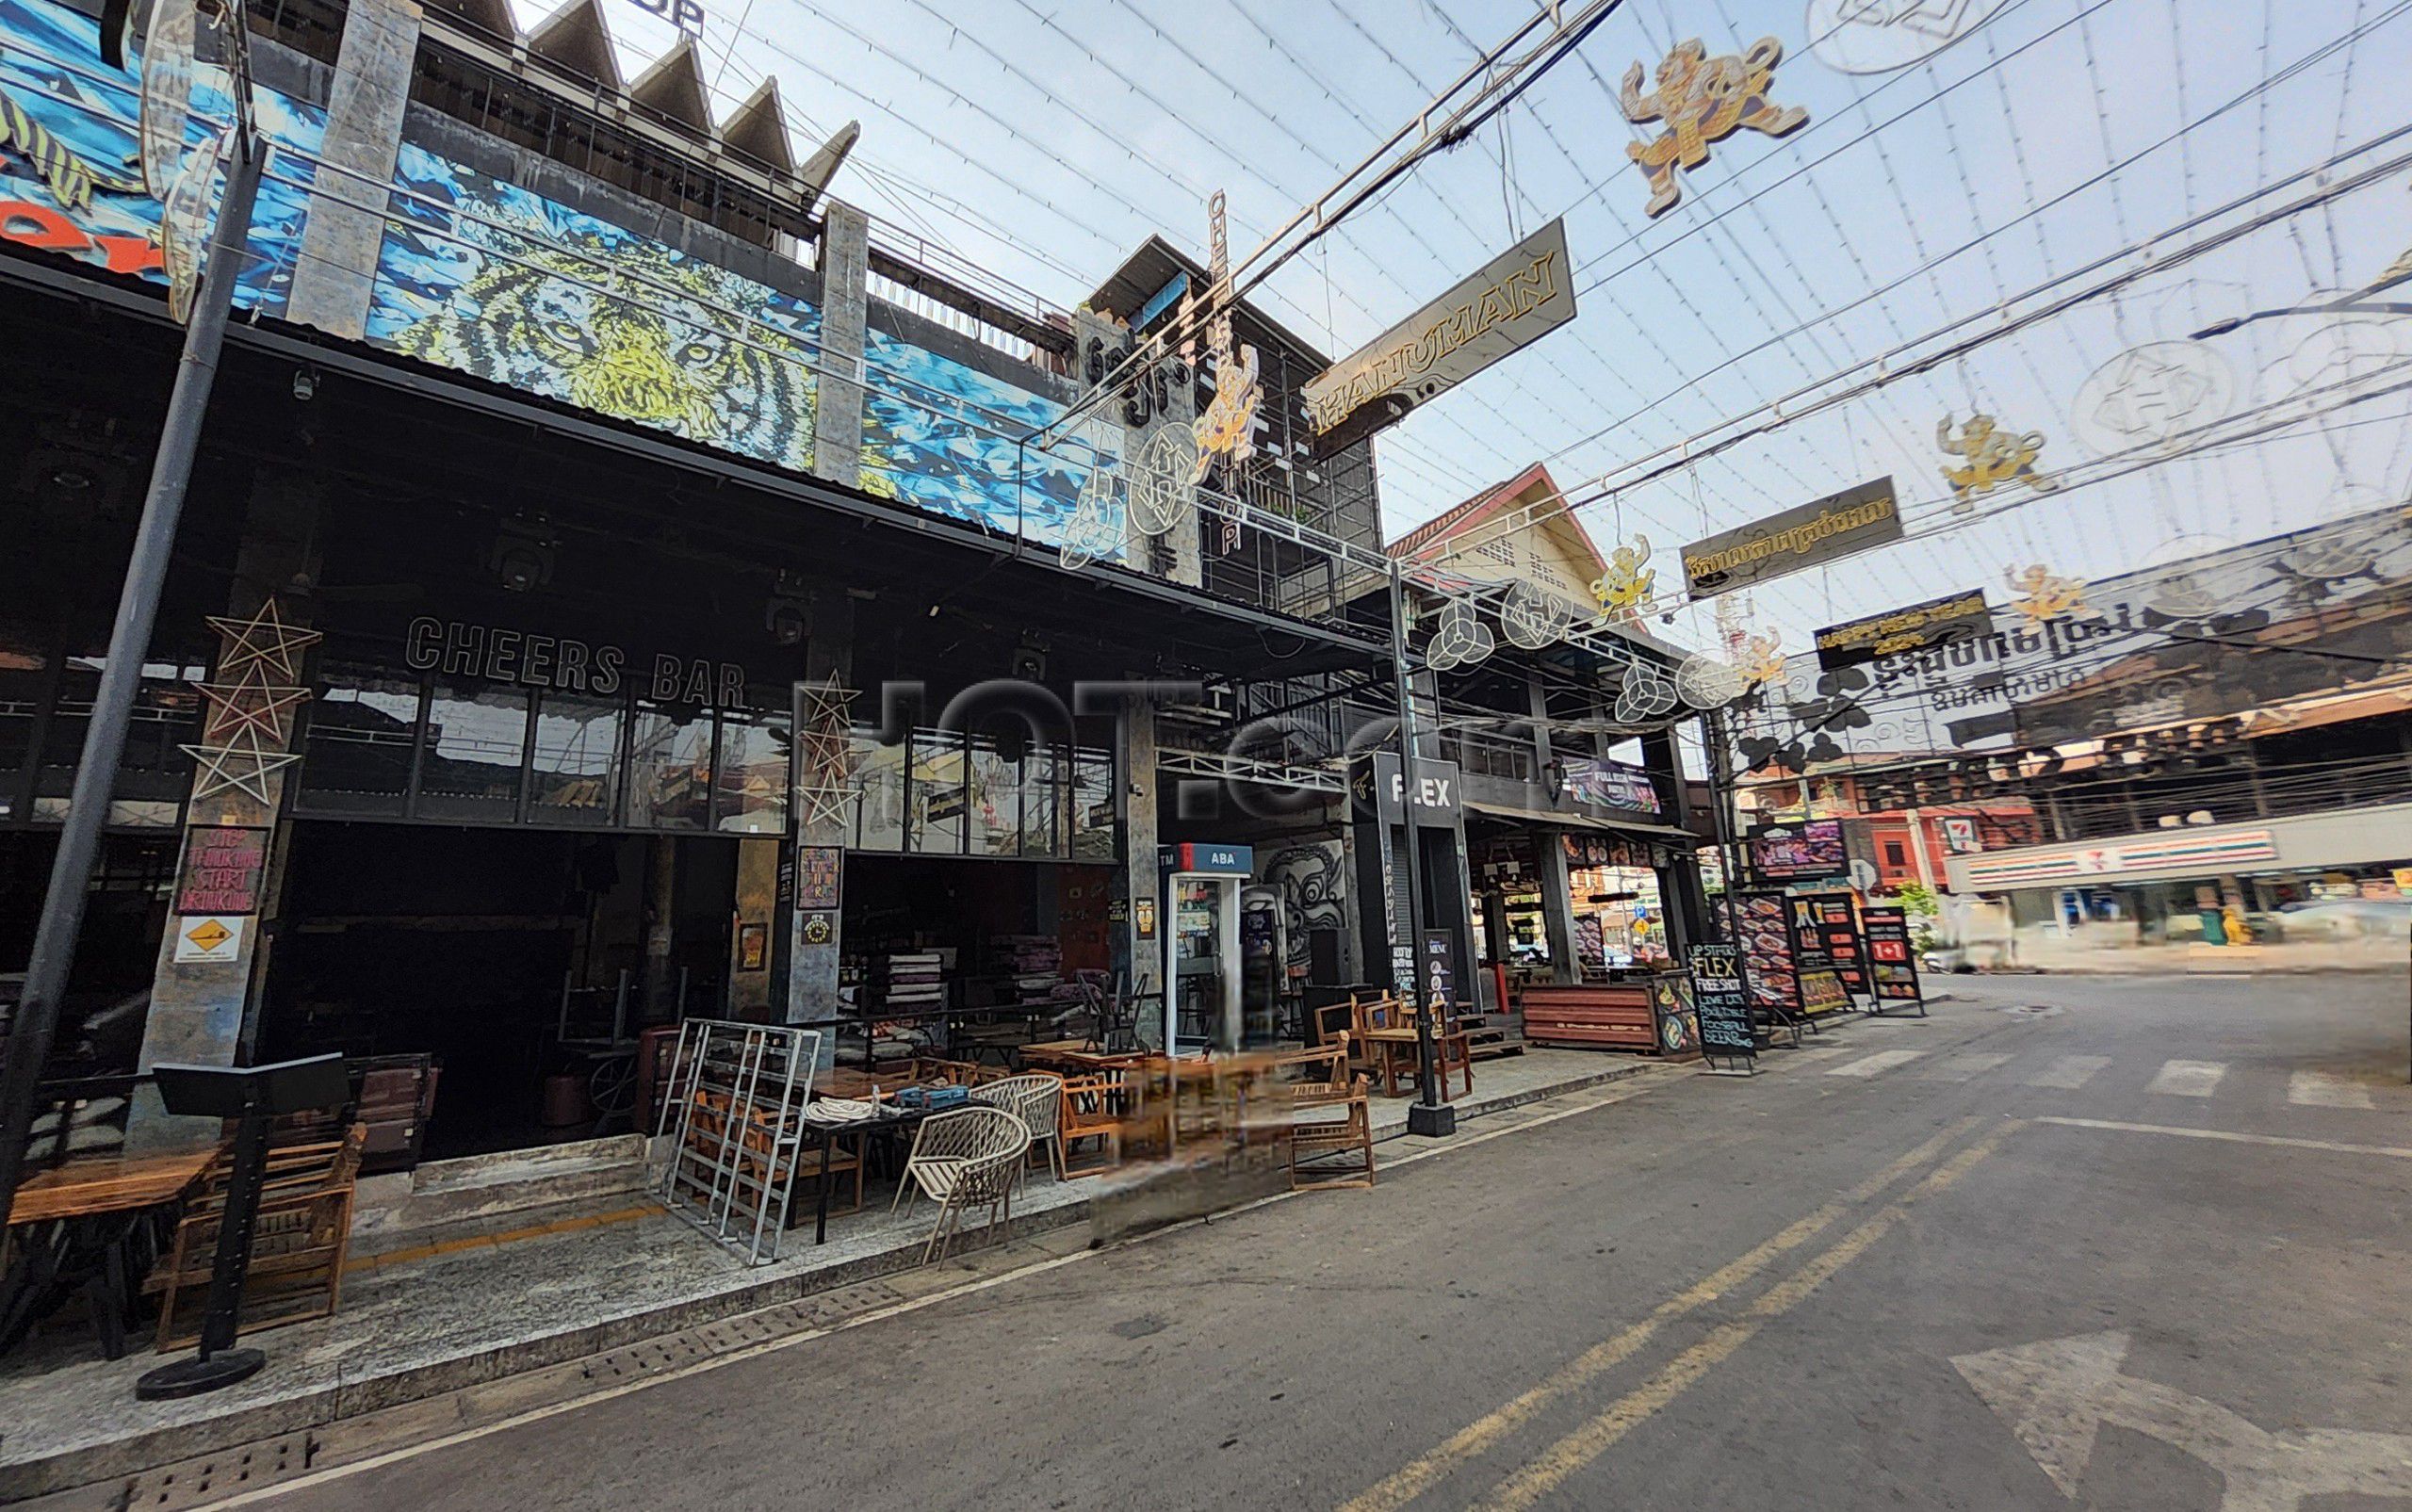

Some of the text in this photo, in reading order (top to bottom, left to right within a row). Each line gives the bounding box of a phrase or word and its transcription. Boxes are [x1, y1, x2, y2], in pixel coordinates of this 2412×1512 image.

[1310, 250, 1556, 436] HANUMAN
[405, 616, 747, 708] CHEERS BAR
[1392, 772, 1451, 807] FEX
[209, 828, 246, 847] STOP
[1211, 852, 1235, 866] ABA
[193, 868, 247, 890] START
[1874, 943, 1903, 959] 1+1
[1695, 957, 1738, 978] FLEX
